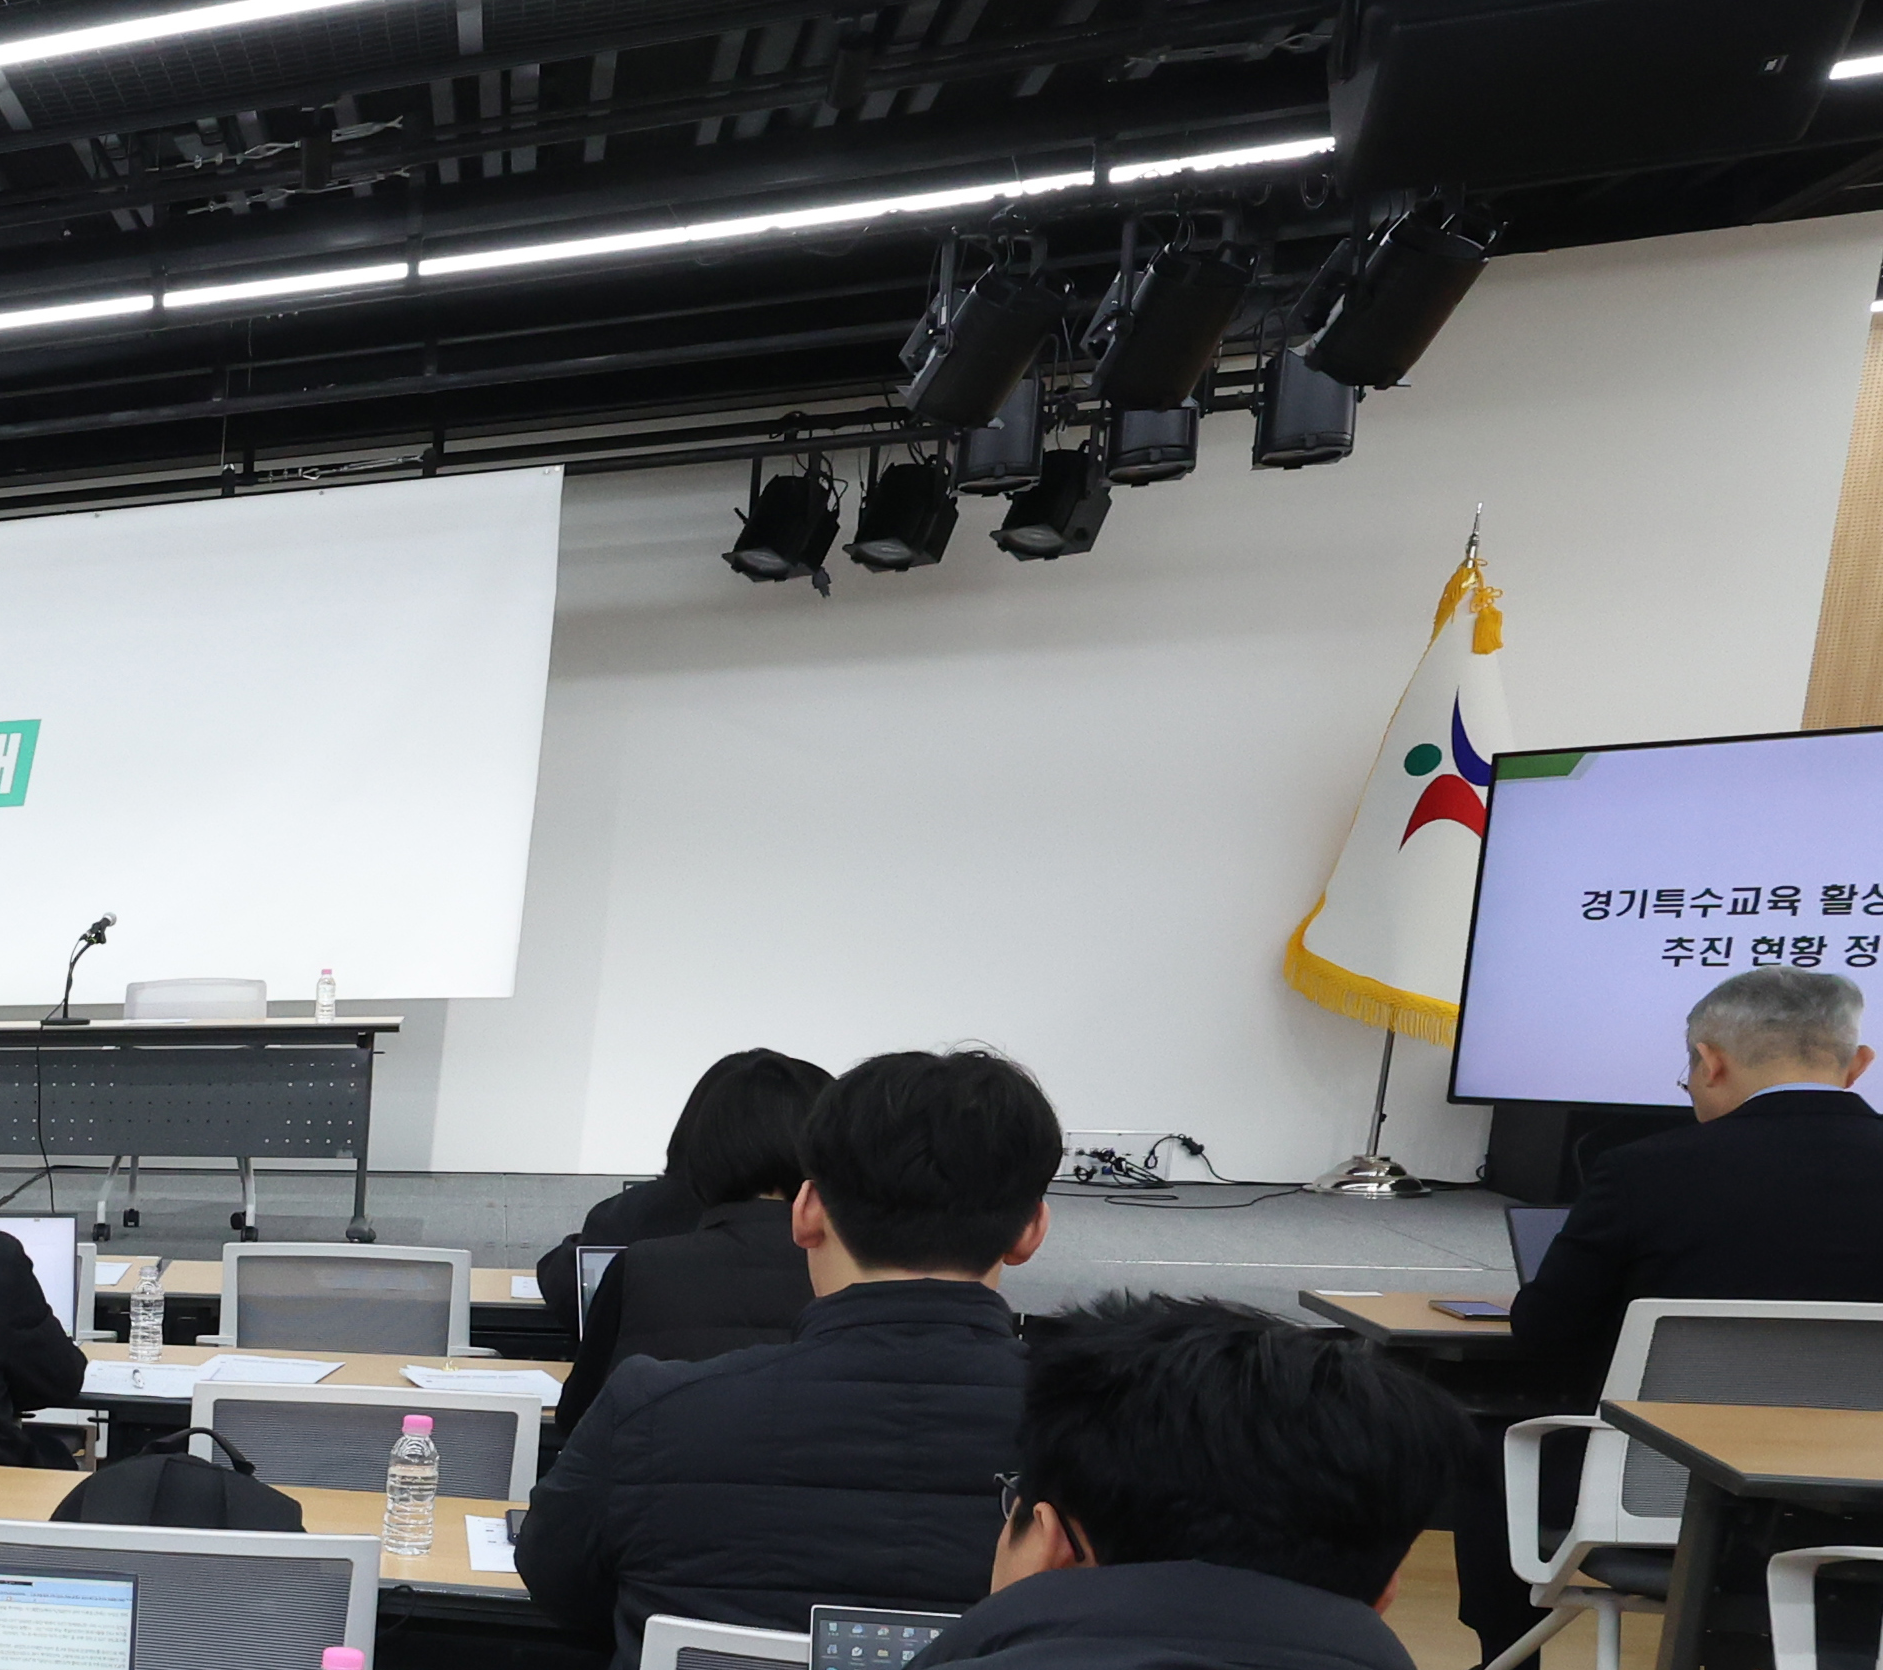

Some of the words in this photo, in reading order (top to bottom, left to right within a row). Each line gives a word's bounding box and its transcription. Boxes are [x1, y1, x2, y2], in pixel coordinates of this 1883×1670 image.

[1580, 885, 1802, 921] 경기특수교육
[1661, 936, 1733, 968] 추진
[1750, 935, 1828, 968] 현황
[1843, 935, 1881, 968] 정
